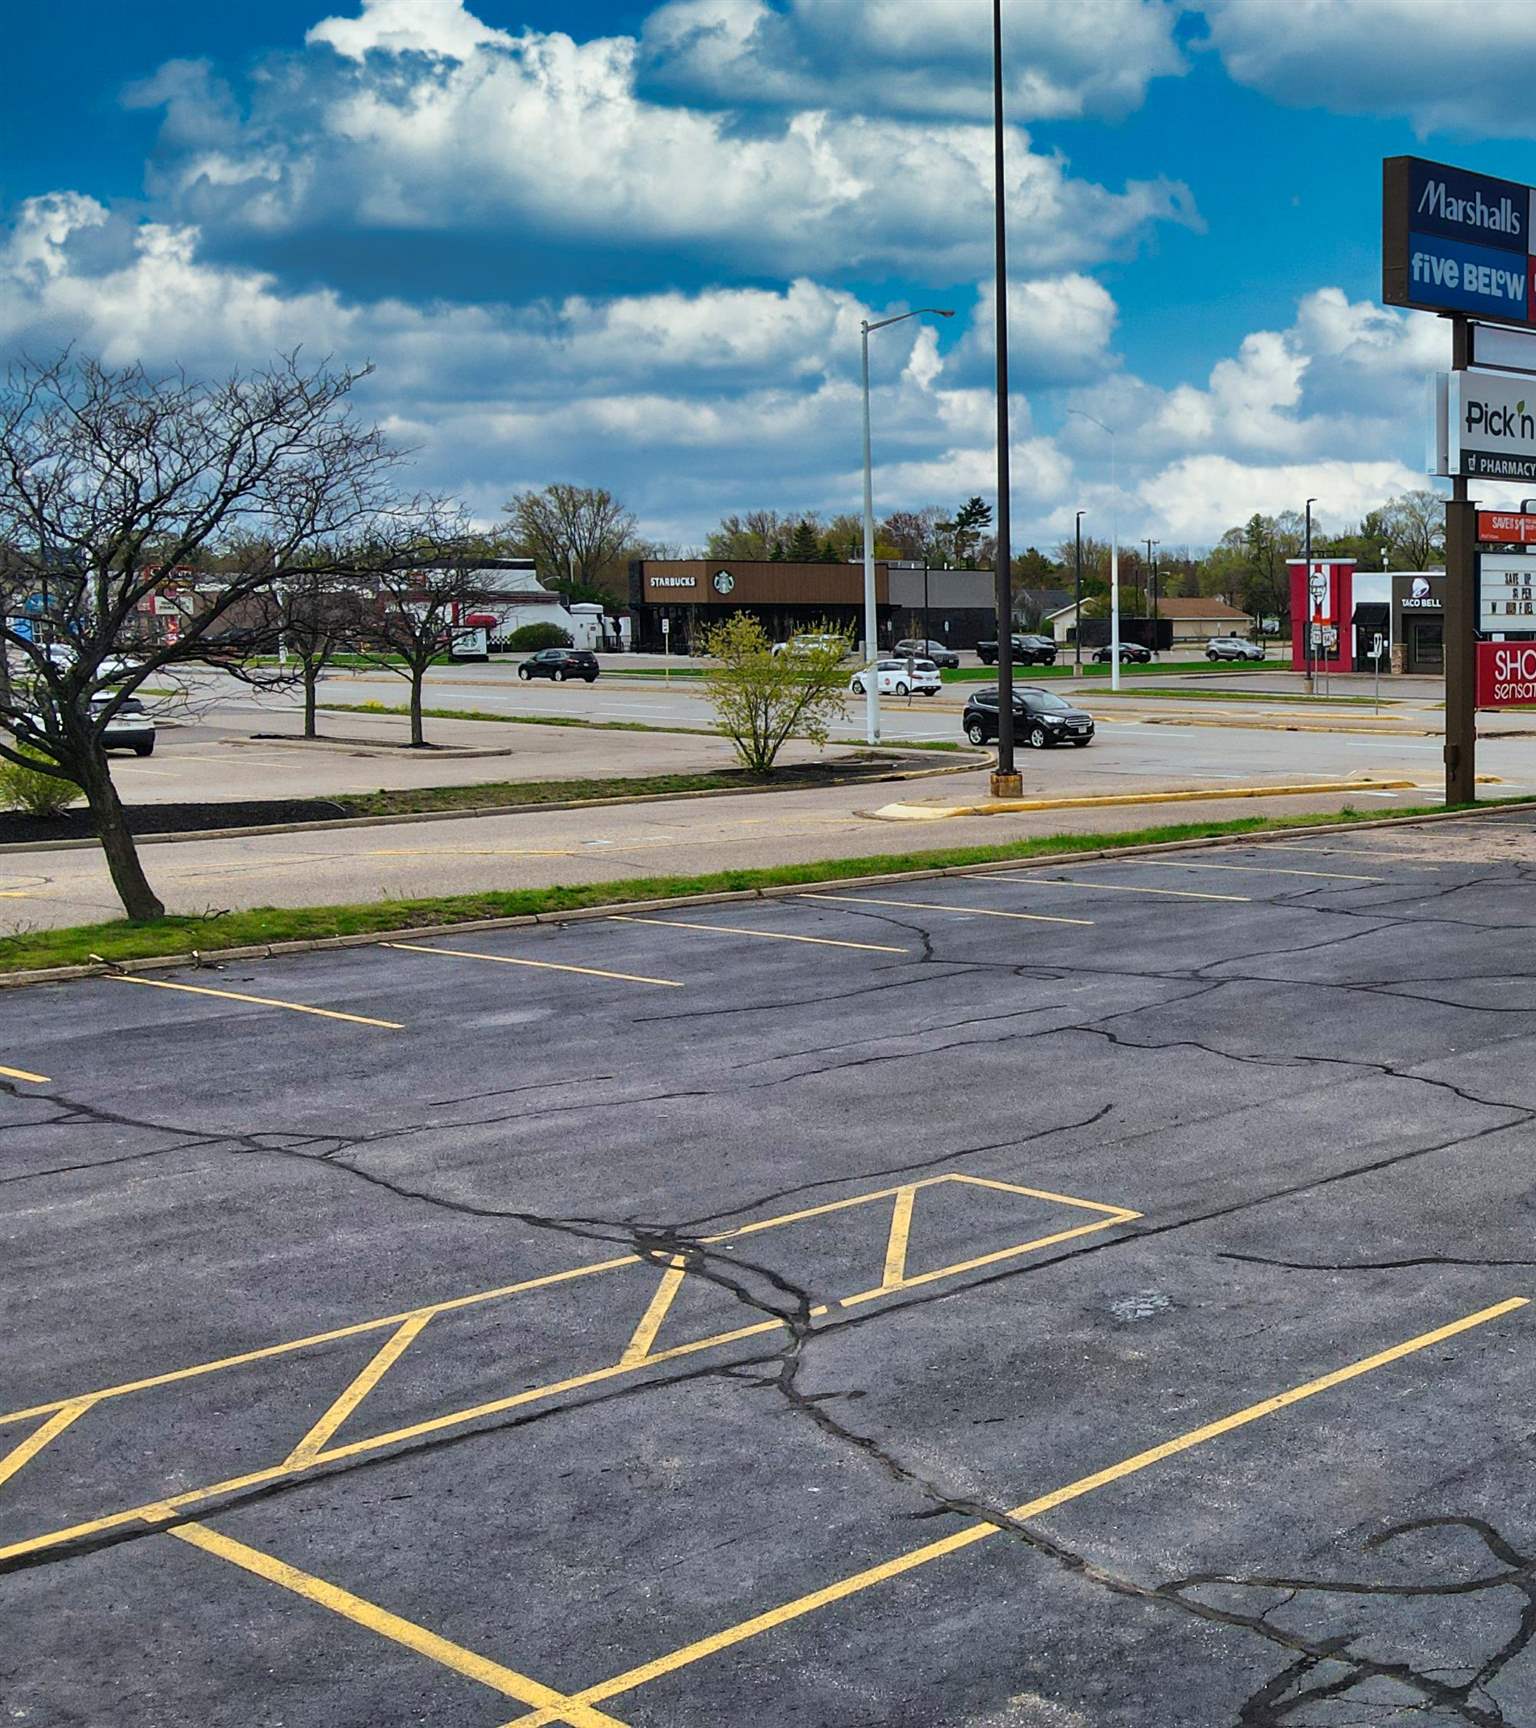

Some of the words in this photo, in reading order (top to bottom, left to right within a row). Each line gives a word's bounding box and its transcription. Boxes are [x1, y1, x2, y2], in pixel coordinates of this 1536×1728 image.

[1417, 180, 1521, 235] Marshalls
[1412, 252, 1460, 289] five
[1463, 262, 1525, 301] BELOW
[1480, 458, 1536, 477] PHARMACY
[650, 576, 696, 587] STARBUCKS
[1505, 572, 1519, 585] SAVE
[1524, 573, 1531, 585] UP
[1521, 587, 1532, 600] PER
[1401, 598, 1421, 607] TACO
[1421, 599, 1442, 608] BELL
